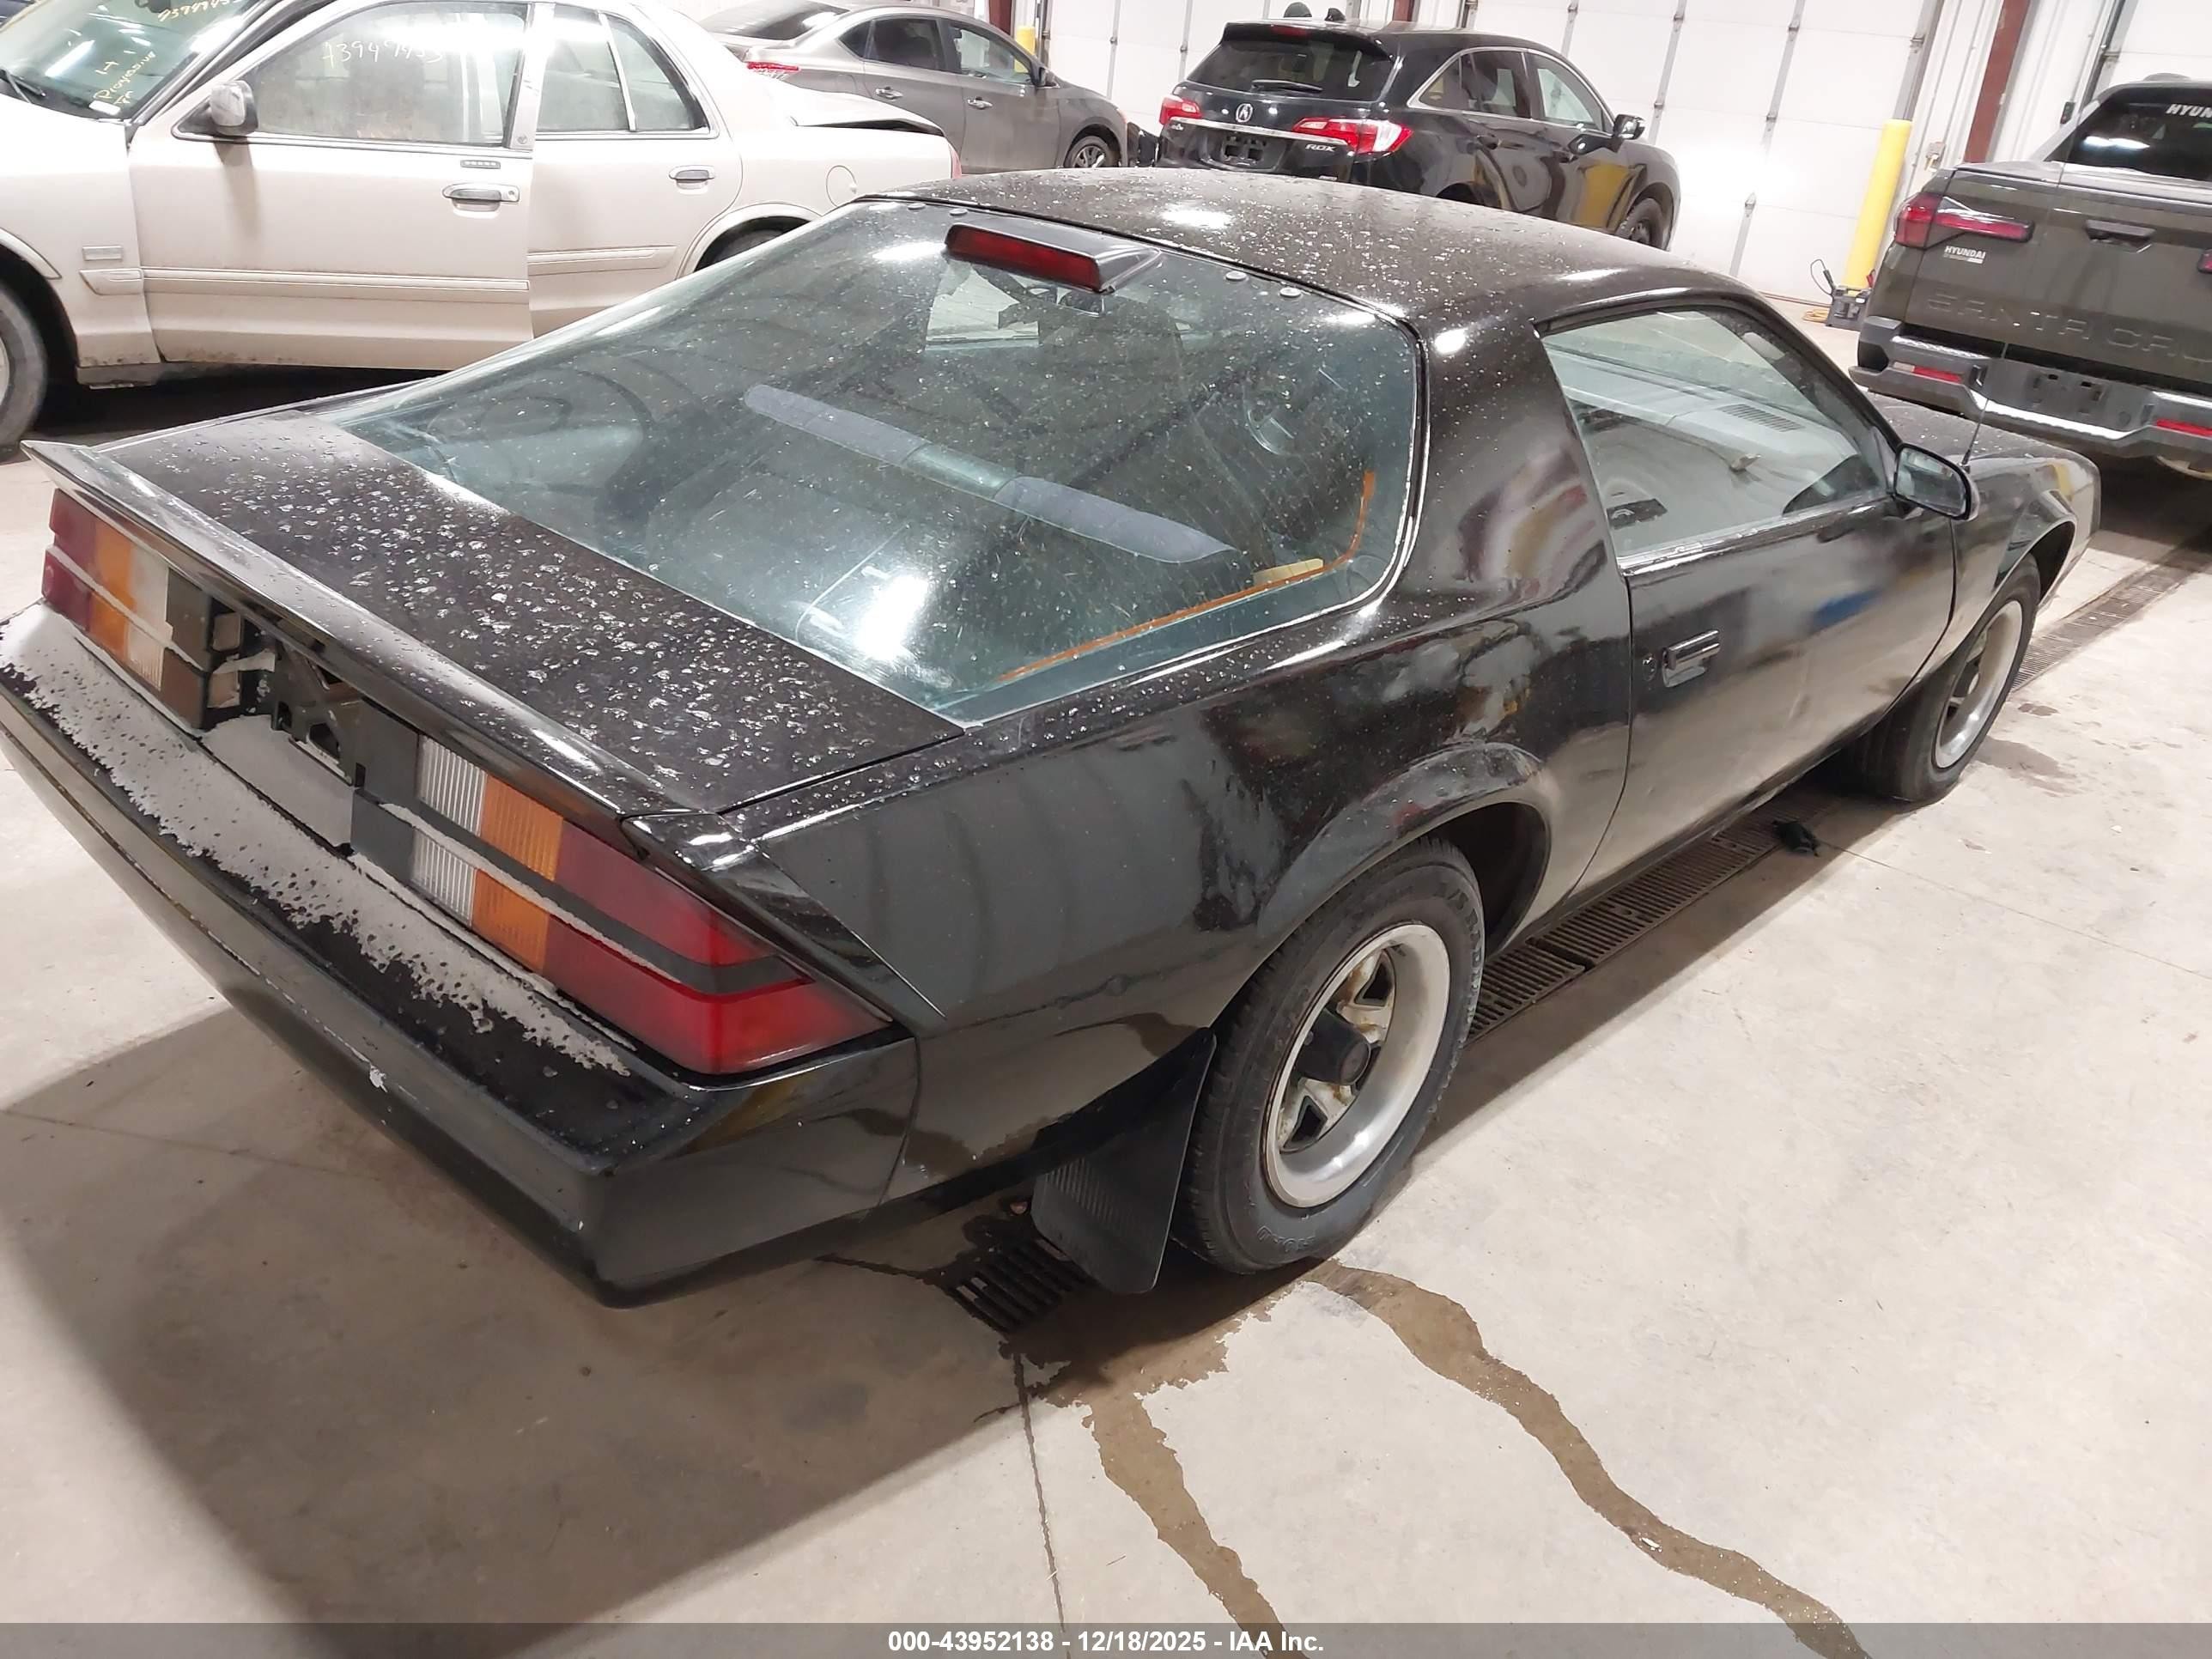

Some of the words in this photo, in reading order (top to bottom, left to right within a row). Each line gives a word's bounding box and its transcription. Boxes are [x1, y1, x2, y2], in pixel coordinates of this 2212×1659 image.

[1305, 143, 1337, 152] RDX
[1944, 246, 1986, 259] HYUNDAI
[1926, 292, 2092, 341] SANTA
